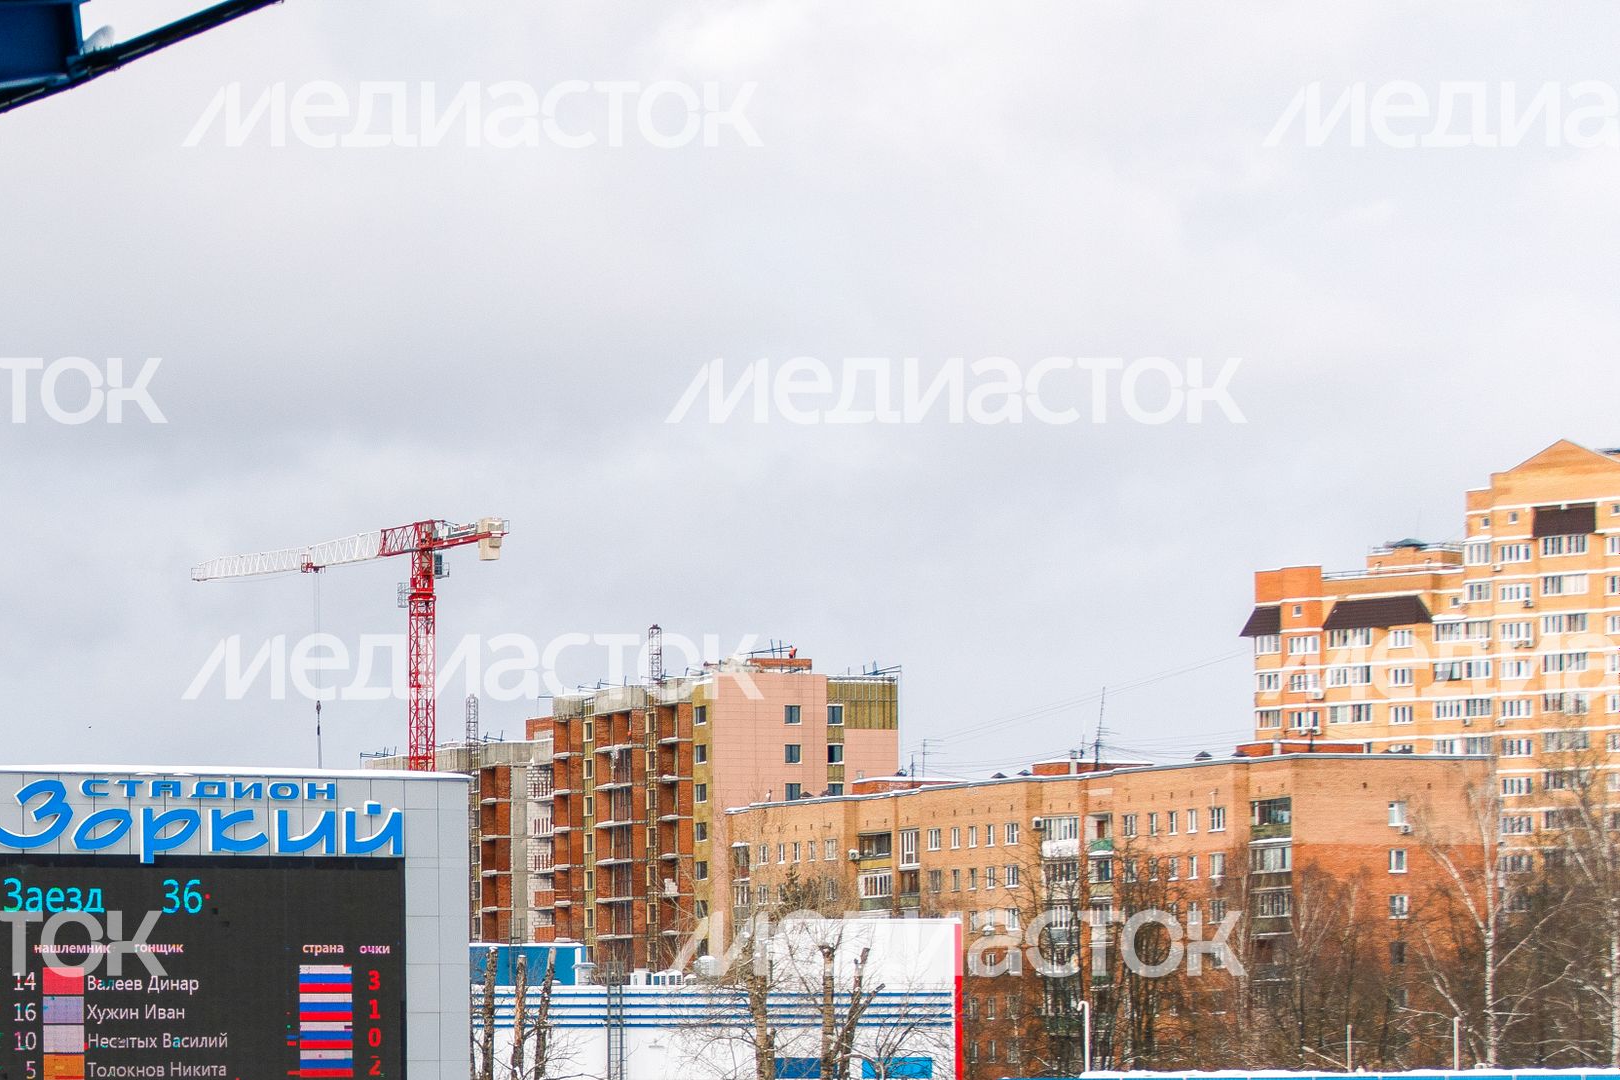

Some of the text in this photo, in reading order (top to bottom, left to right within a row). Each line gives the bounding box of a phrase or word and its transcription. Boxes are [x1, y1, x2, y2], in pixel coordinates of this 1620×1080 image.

[79, 778, 337, 800] СТАДИОН
[3, 878, 203, 915] Заезд 36
[34, 943, 391, 956] нашлемник гонщик страна очки
[13, 970, 381, 995] 14 Валеев Динар 3
[13, 999, 381, 1024] 16 Хужин Иван 1
[14, 1028, 381, 1051] 10 Несытых Василий 0
[26, 1055, 381, 1080] 5 Толокнов Никита 2
